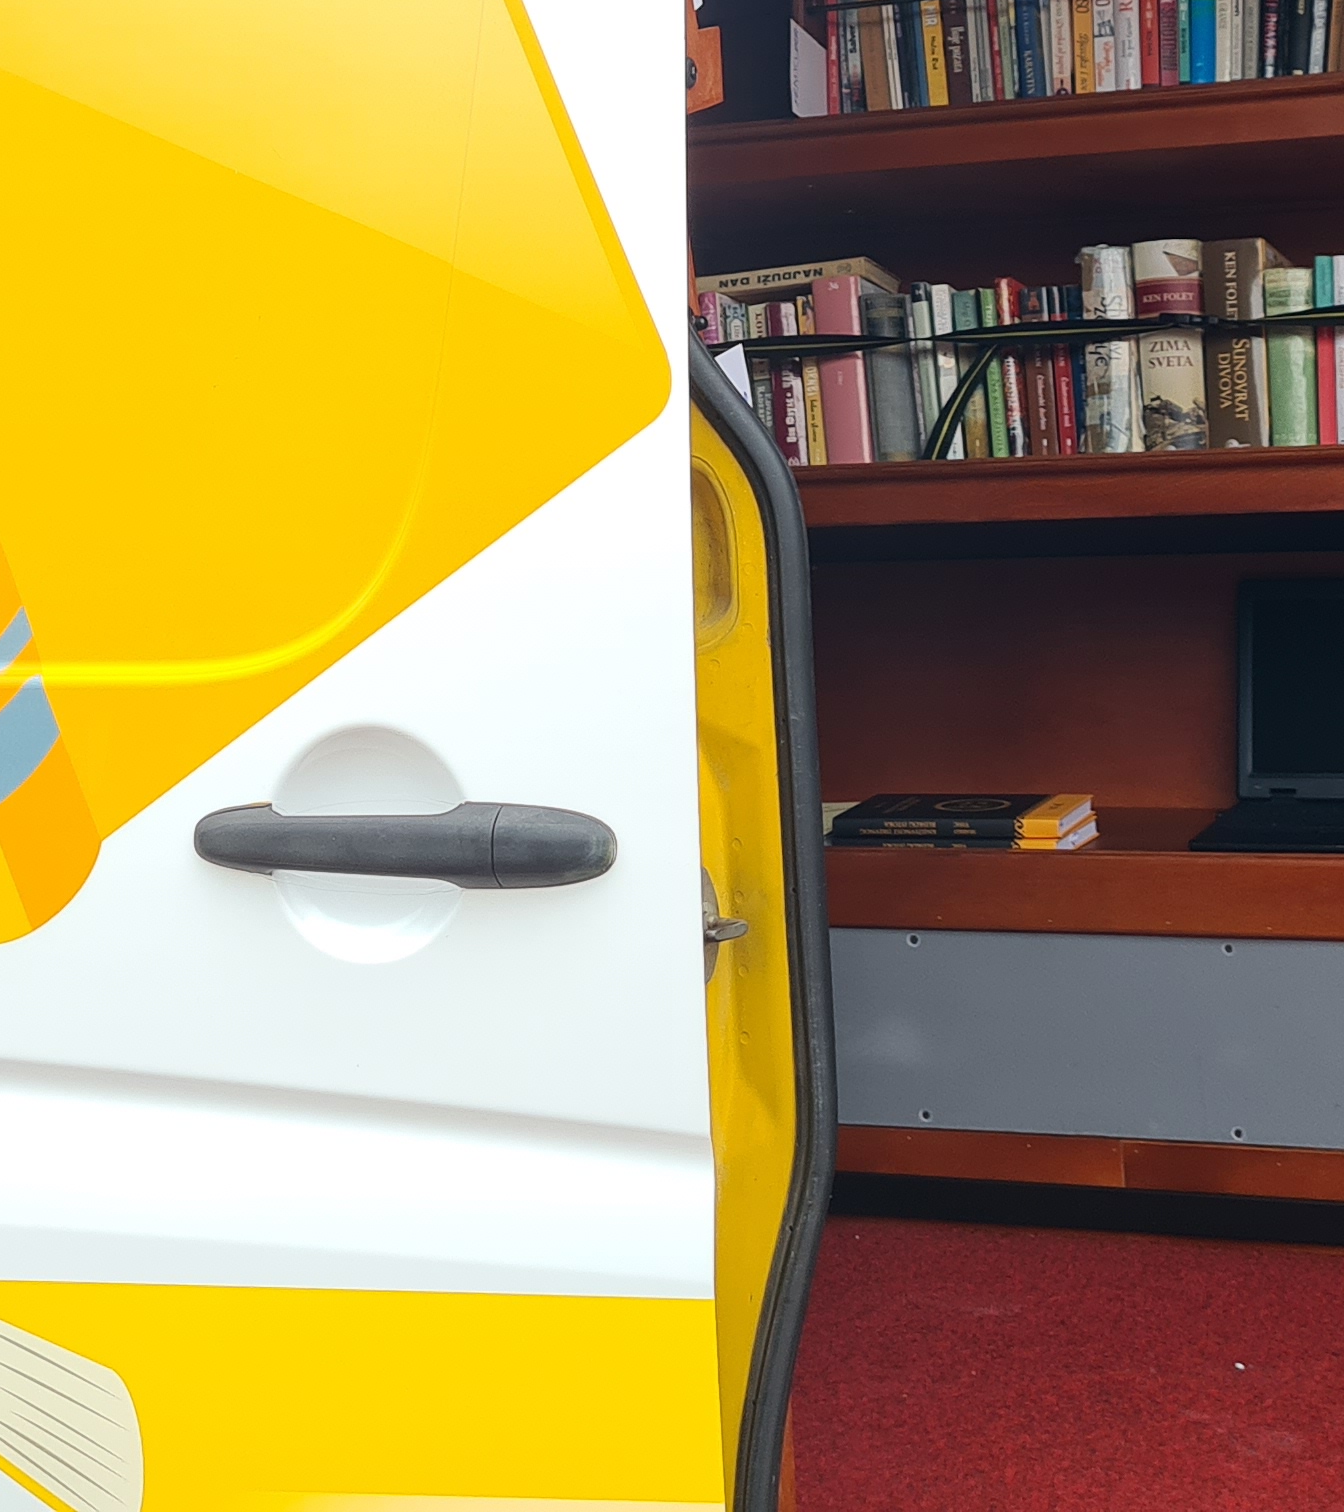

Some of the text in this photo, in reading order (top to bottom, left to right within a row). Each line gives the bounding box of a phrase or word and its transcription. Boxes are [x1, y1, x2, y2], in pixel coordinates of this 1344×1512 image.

[718, 267, 823, 289] NAJDUŽI DAN
[1224, 252, 1239, 321] KEN FOLET
[1142, 291, 1195, 303] KEN FOLET
[1149, 340, 1192, 353] ZIMA
[1148, 356, 1194, 368] SVETA
[1218, 353, 1231, 409] DIVOVA
[1232, 339, 1250, 421] SUNOVRAT
